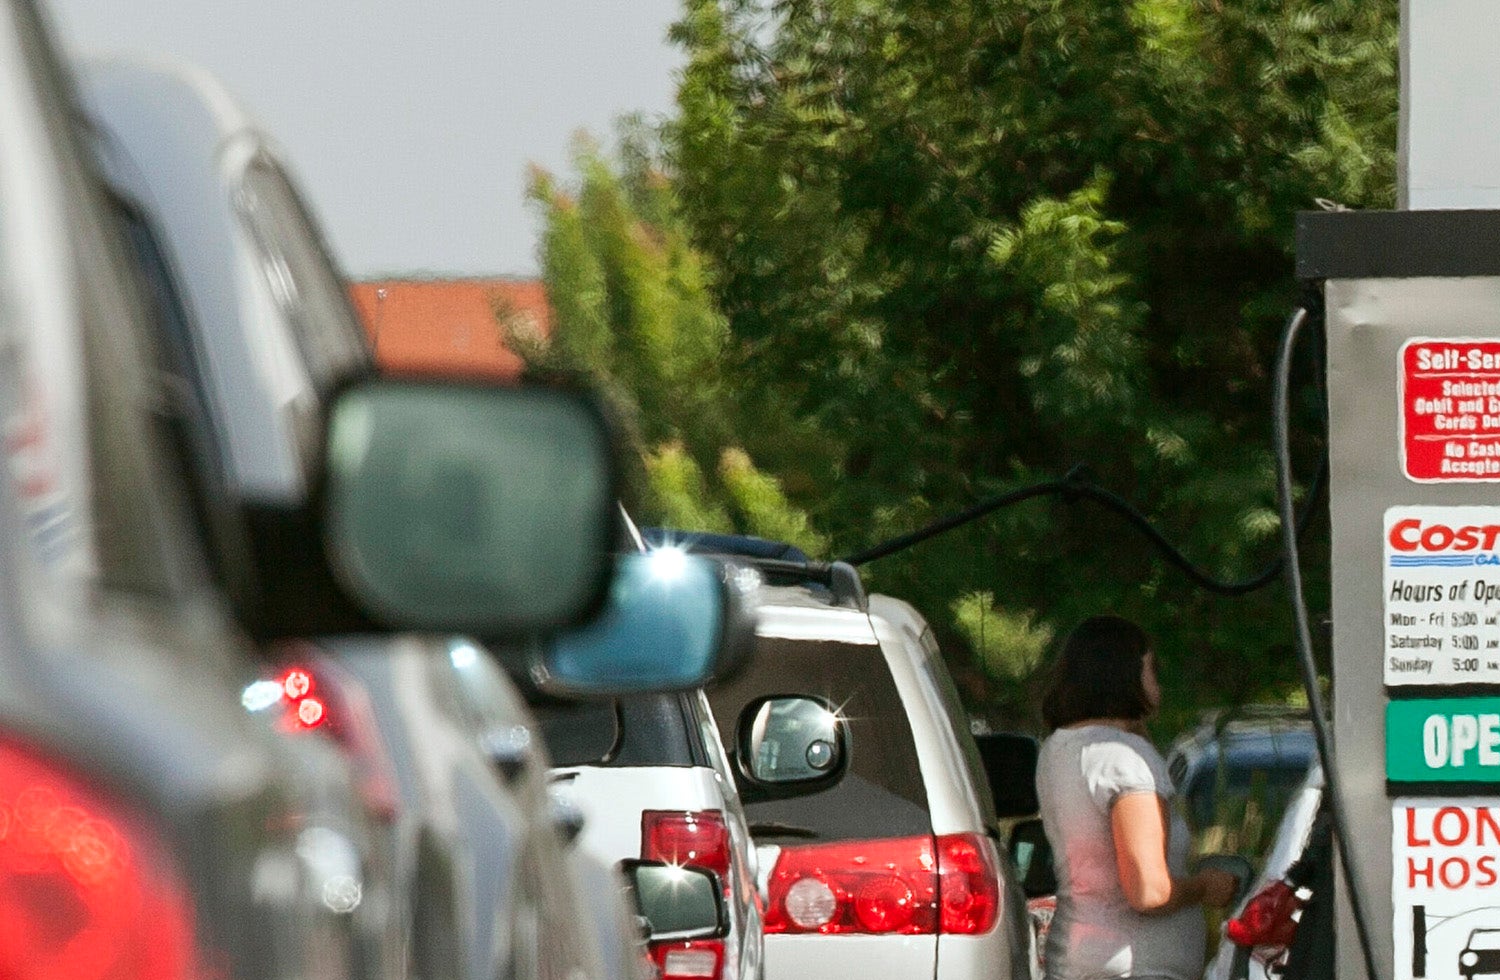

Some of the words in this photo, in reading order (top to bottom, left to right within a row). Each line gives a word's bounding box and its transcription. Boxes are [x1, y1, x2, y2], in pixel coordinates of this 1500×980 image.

[1414, 398, 1453, 415] Debit
[1458, 398, 1484, 413] and
[1434, 414, 1477, 430] Cards
[1445, 441, 1464, 458] No
[1390, 580, 1443, 602] Hours
[1449, 580, 1468, 602] of
[1390, 612, 1417, 627] Mon
[1429, 612, 1444, 627] Fri
[1451, 612, 1478, 627] 5:00
[1390, 635, 1443, 651] Saturday
[1451, 635, 1479, 650] 5:00
[1390, 657, 1434, 674] Sunday
[1452, 658, 1479, 673] 5:00
